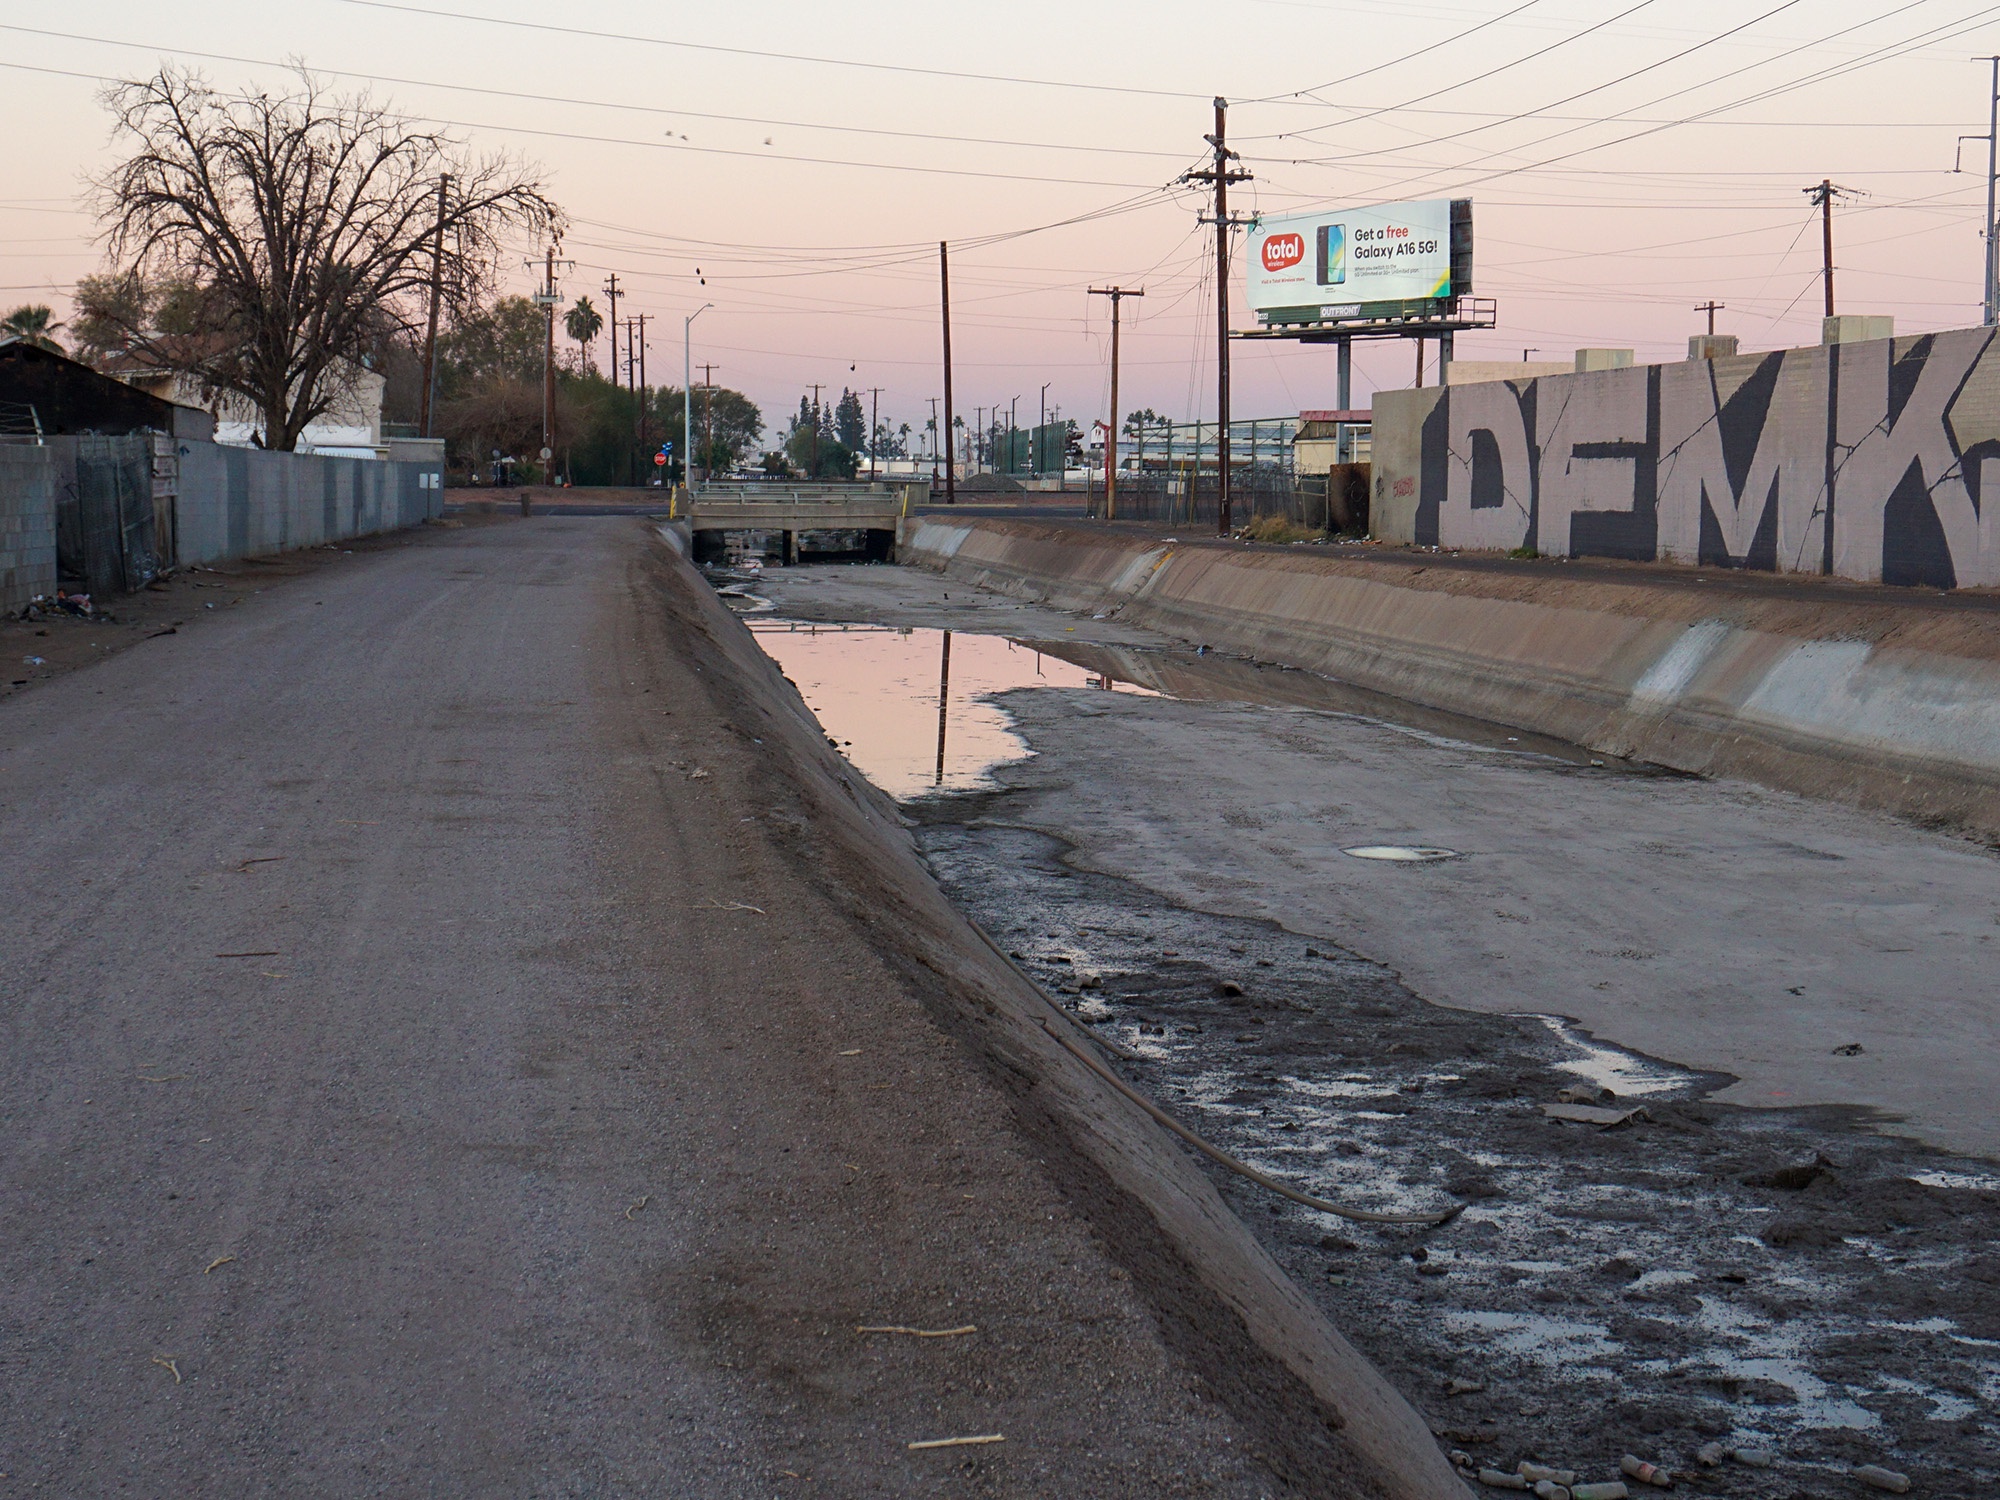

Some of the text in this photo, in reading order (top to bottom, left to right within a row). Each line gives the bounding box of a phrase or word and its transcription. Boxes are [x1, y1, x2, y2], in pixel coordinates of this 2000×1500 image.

[1354, 225, 1409, 242] Get a free
[1266, 236, 1299, 260] total
[1354, 240, 1438, 259] Galaxy A16 5G!
[1321, 306, 1359, 316] OUTFRONT
